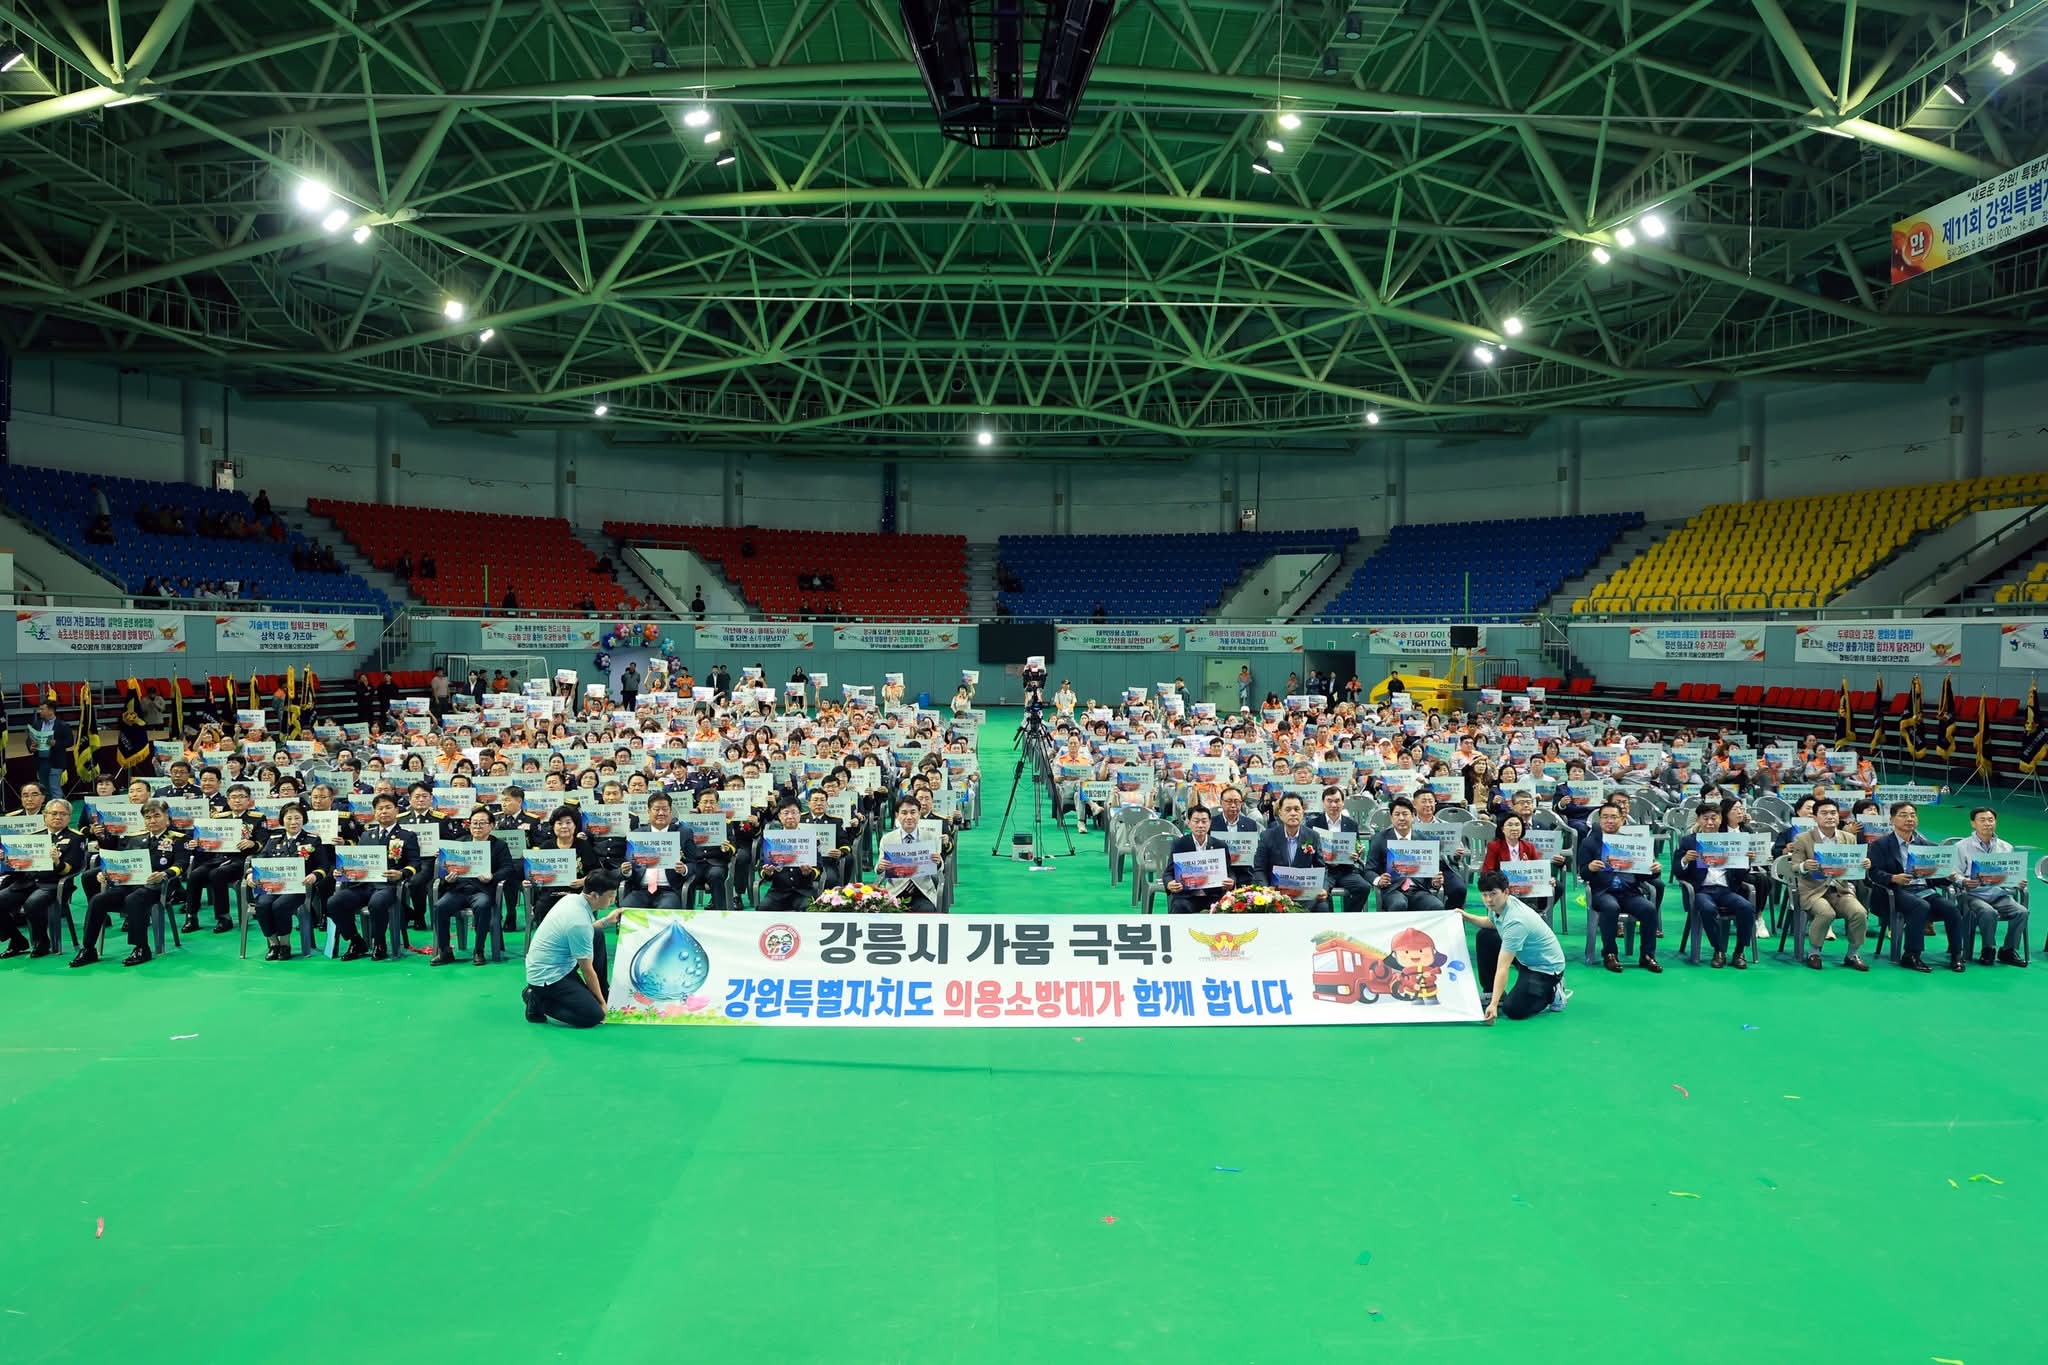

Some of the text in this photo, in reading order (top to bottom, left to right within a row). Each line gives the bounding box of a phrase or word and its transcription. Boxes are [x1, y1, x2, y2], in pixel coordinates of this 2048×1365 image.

[1998, 172, 2019, 192] 강원!
[1943, 205, 1982, 245] 제11회
[248, 620, 271, 631] 기술력
[290, 620, 311, 631] 팀워크
[312, 620, 328, 631] 완벽!
[261, 632, 275, 641] 삼척
[277, 632, 291, 641] 우승
[1414, 631, 1428, 639] GO!
[1430, 631, 1445, 639] GO!
[1407, 640, 1447, 648] FIGHTING
[1694, 641, 1706, 650] 우승
[820, 923, 1172, 965] 강릉시 가뭄 극복!
[725, 977, 1293, 1019] 강원특별자치도 의용소방대가 함께 합니다
